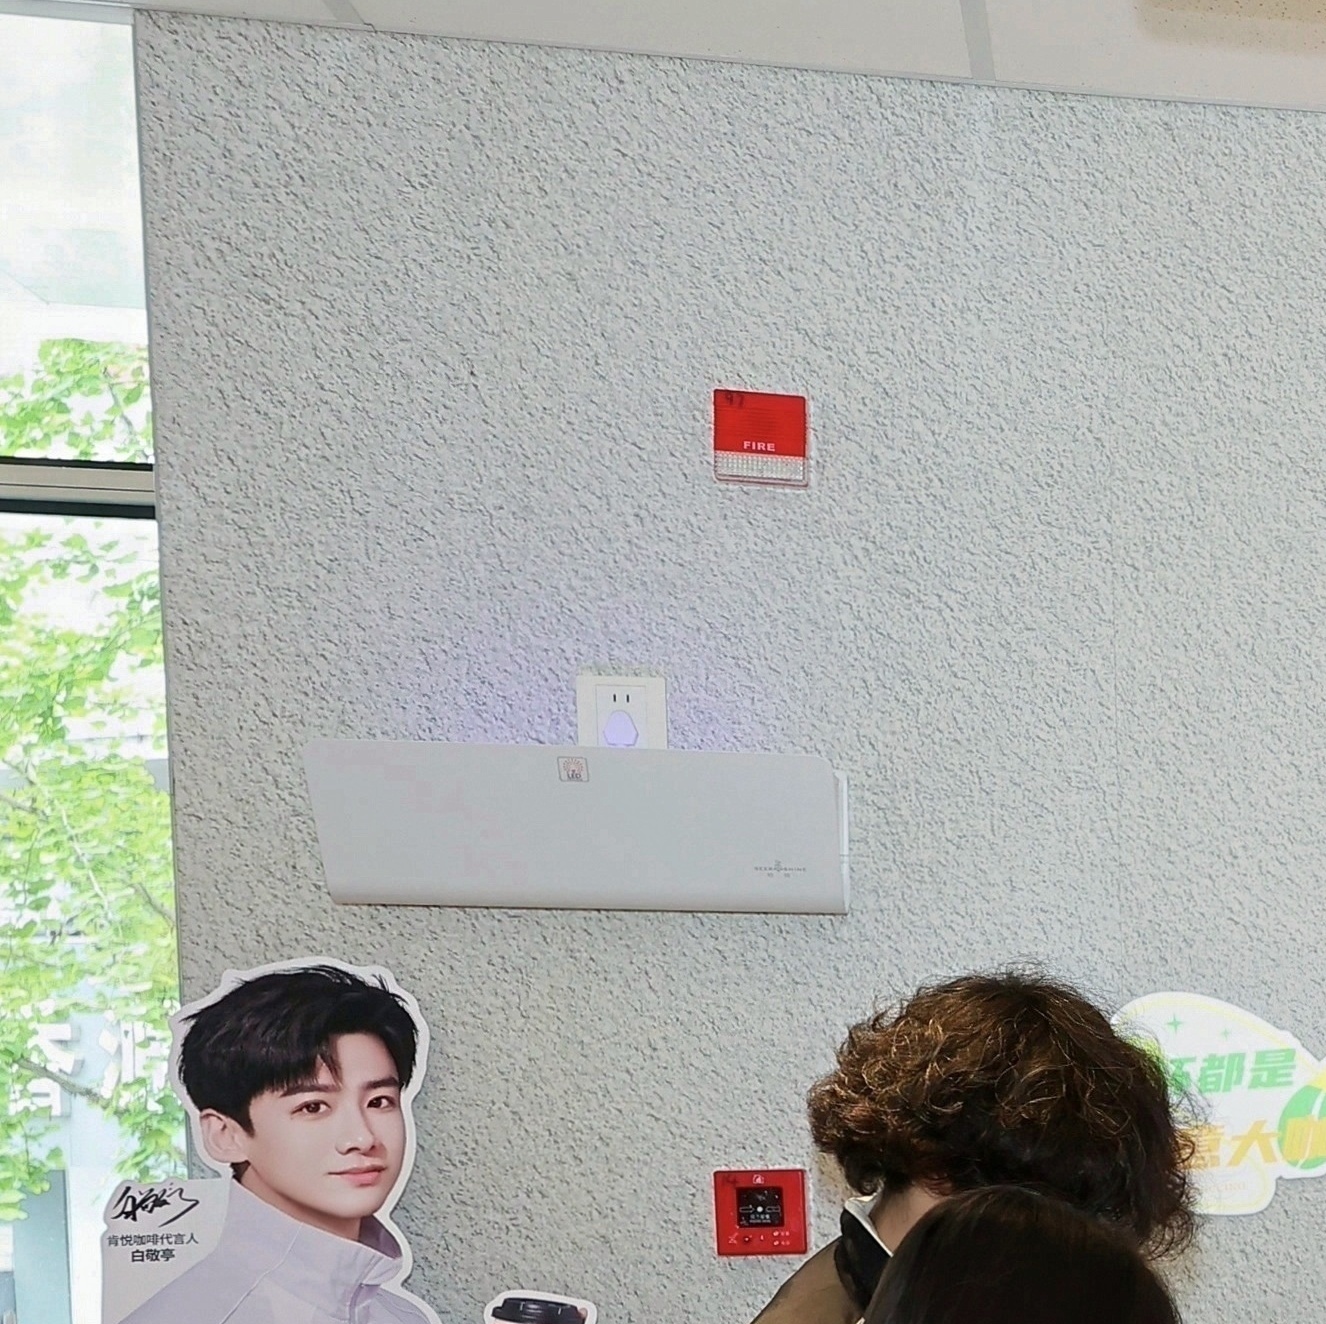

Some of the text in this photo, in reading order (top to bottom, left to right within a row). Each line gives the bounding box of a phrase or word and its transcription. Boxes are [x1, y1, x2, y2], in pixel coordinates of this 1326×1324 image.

[743, 440, 776, 452] FIRE
[106, 1231, 199, 1248] 肯悦咖啡代言人
[131, 1247, 176, 1263] 白敬亭
